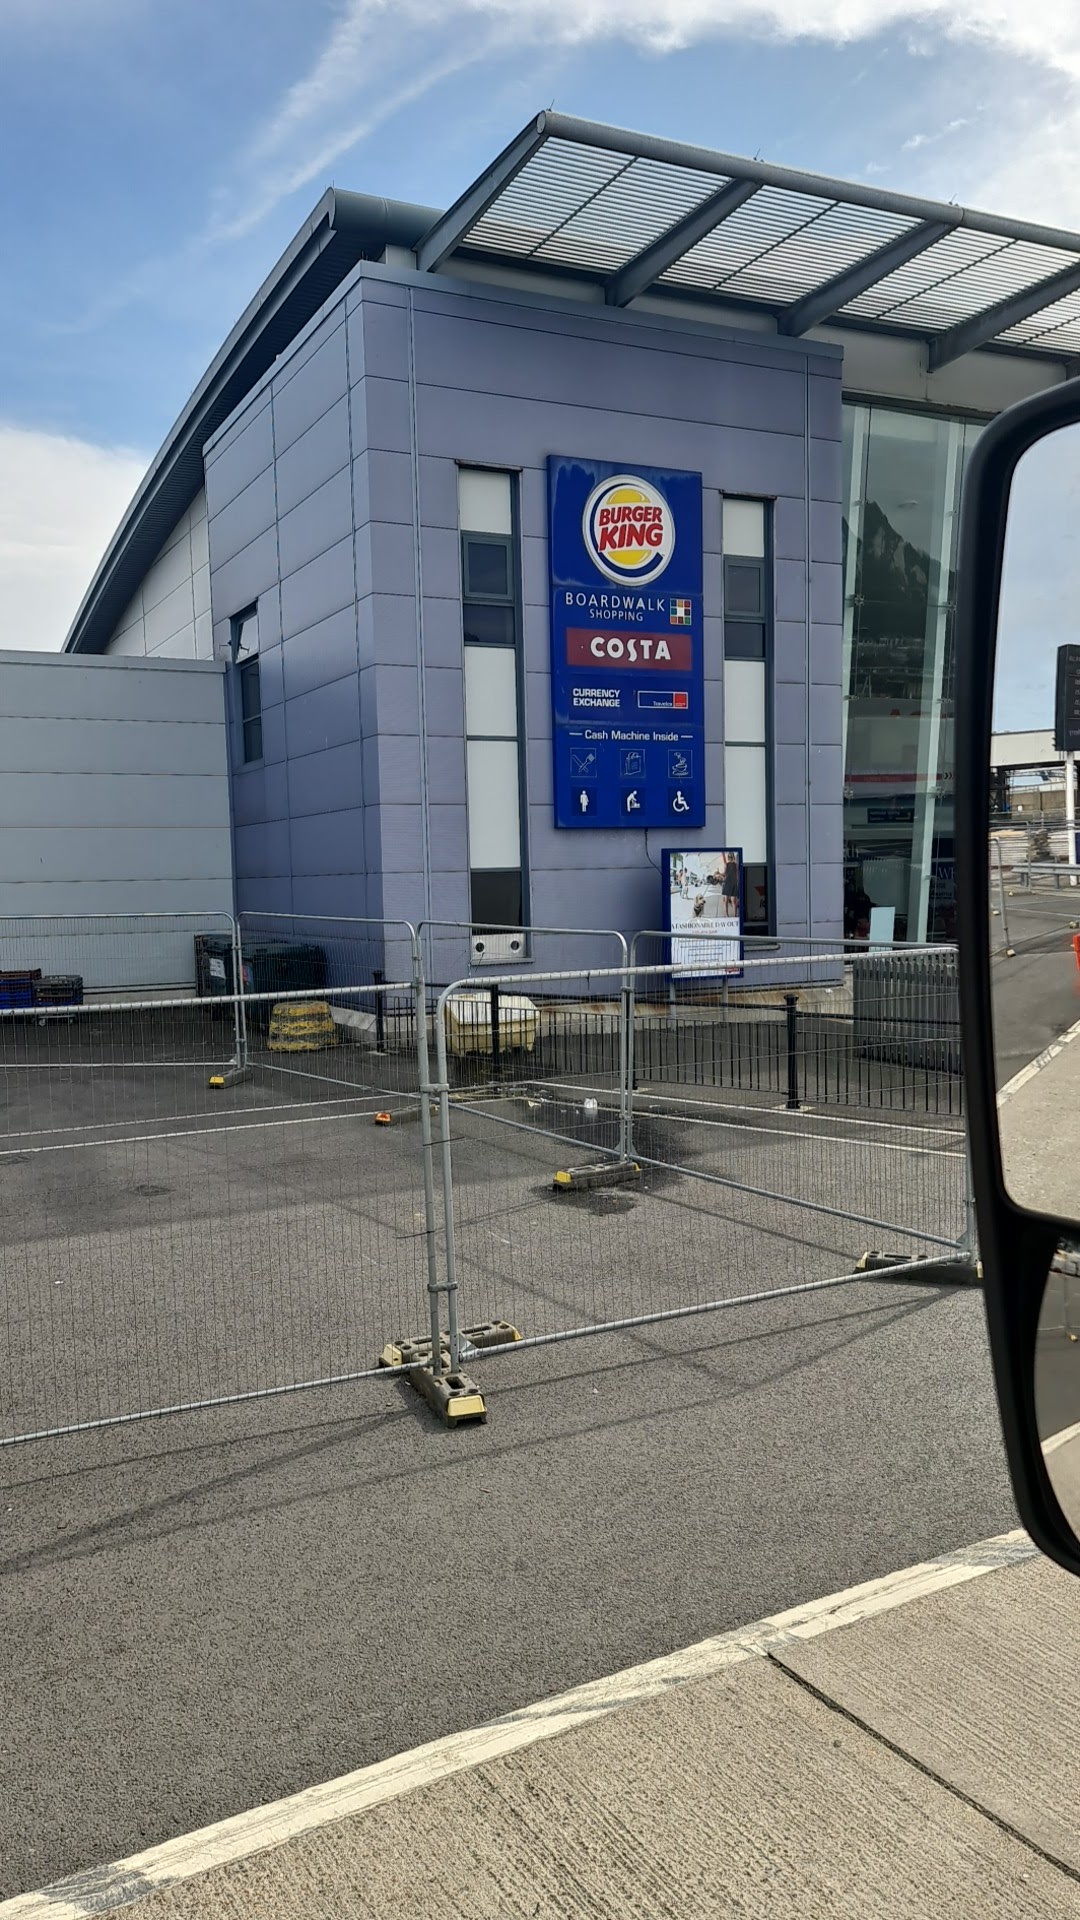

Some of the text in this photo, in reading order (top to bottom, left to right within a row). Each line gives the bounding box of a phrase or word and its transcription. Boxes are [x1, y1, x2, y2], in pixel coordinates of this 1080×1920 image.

[599, 507, 662, 526] BURGER
[599, 523, 663, 551] KING
[565, 592, 665, 611] BOARDWALK
[590, 608, 643, 622] SHOPPING
[590, 637, 671, 662] COSTA
[573, 688, 620, 698] CURRENCY
[573, 698, 620, 708] EXCHANGE
[584, 730, 679, 742] Cash Machine Inside
